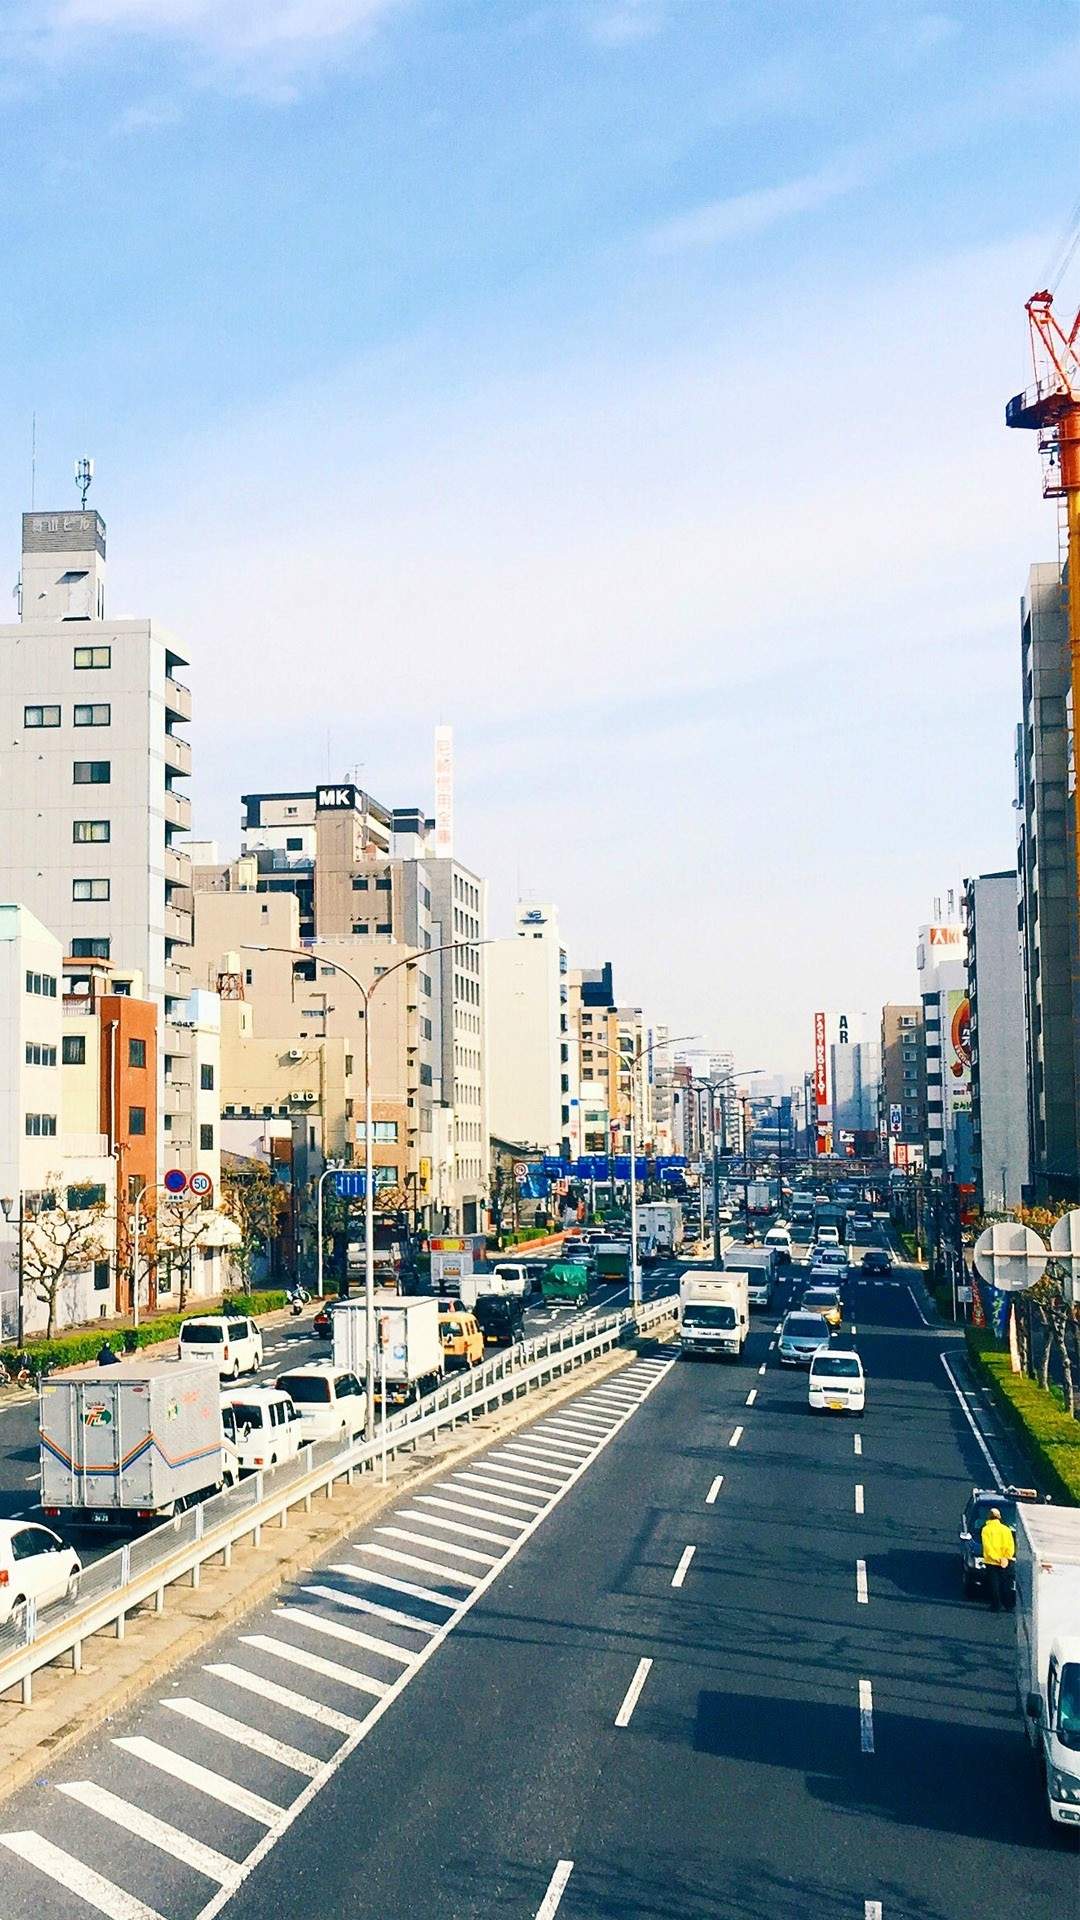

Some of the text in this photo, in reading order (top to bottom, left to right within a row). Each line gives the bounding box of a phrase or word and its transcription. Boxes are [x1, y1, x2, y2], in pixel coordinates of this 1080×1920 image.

[319, 790, 350, 805] MK
[839, 1015, 848, 1044] AR
[194, 1178, 208, 1190] 50
